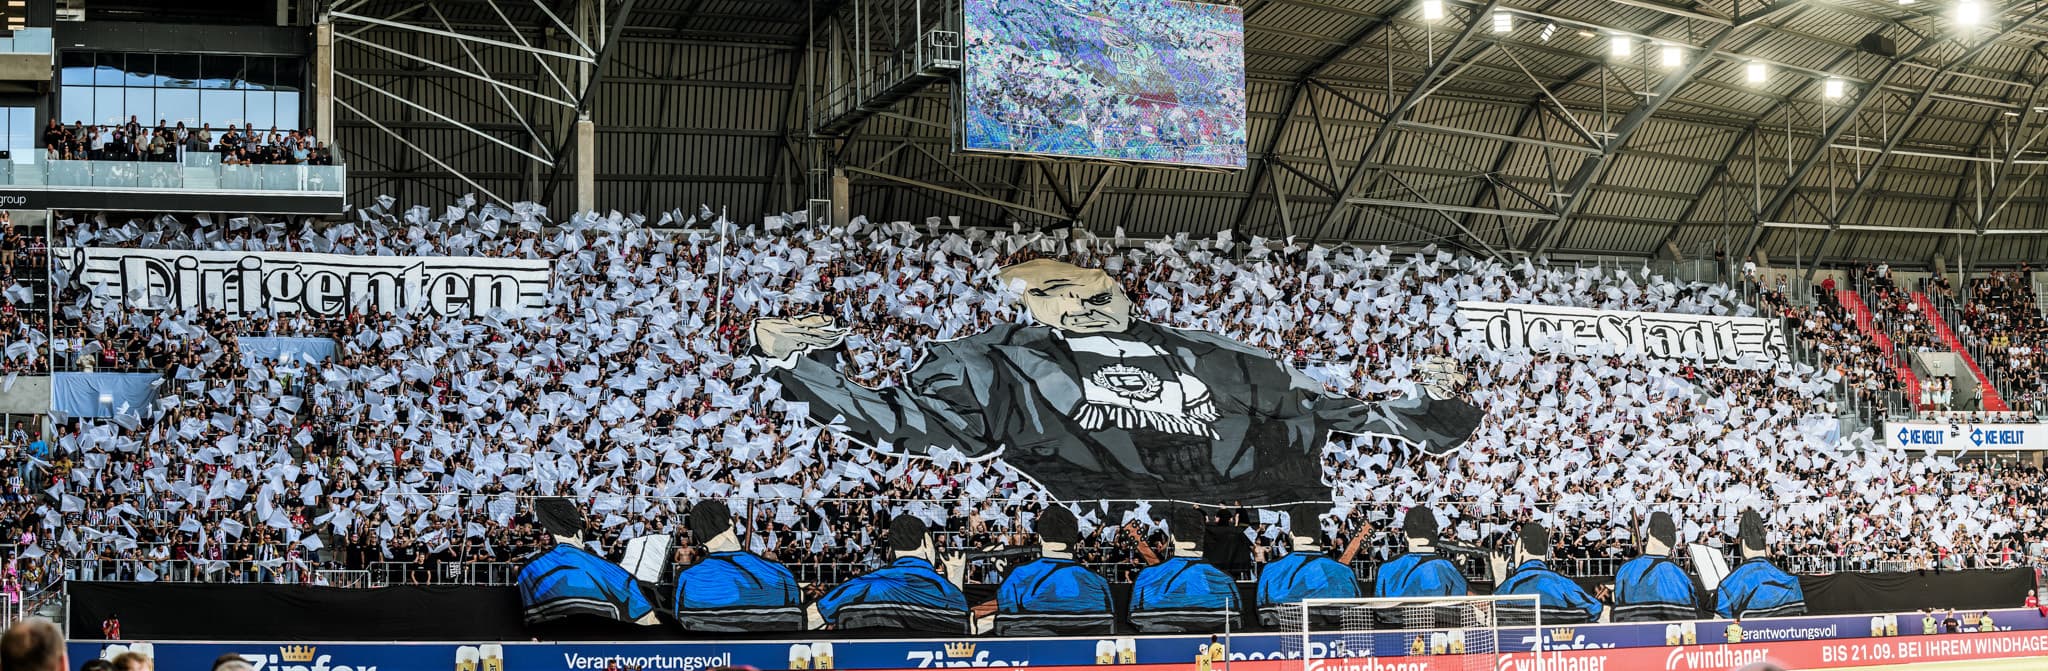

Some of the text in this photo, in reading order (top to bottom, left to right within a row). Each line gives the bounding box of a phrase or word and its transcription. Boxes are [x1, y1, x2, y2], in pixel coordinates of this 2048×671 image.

[0, 195, 27, 206] group
[120, 255, 520, 319] Dirigenten
[1485, 308, 1744, 365] der Stadt
[1910, 429, 1944, 445] KE KELIT
[1985, 429, 2025, 445] KE KELIT
[1743, 624, 1837, 641] erantwortungsvoll
[1822, 635, 2048, 662] BIS 21.09. BEI IHREM WINDHAGE
[564, 652, 731, 671] Verantwortungsvoll
